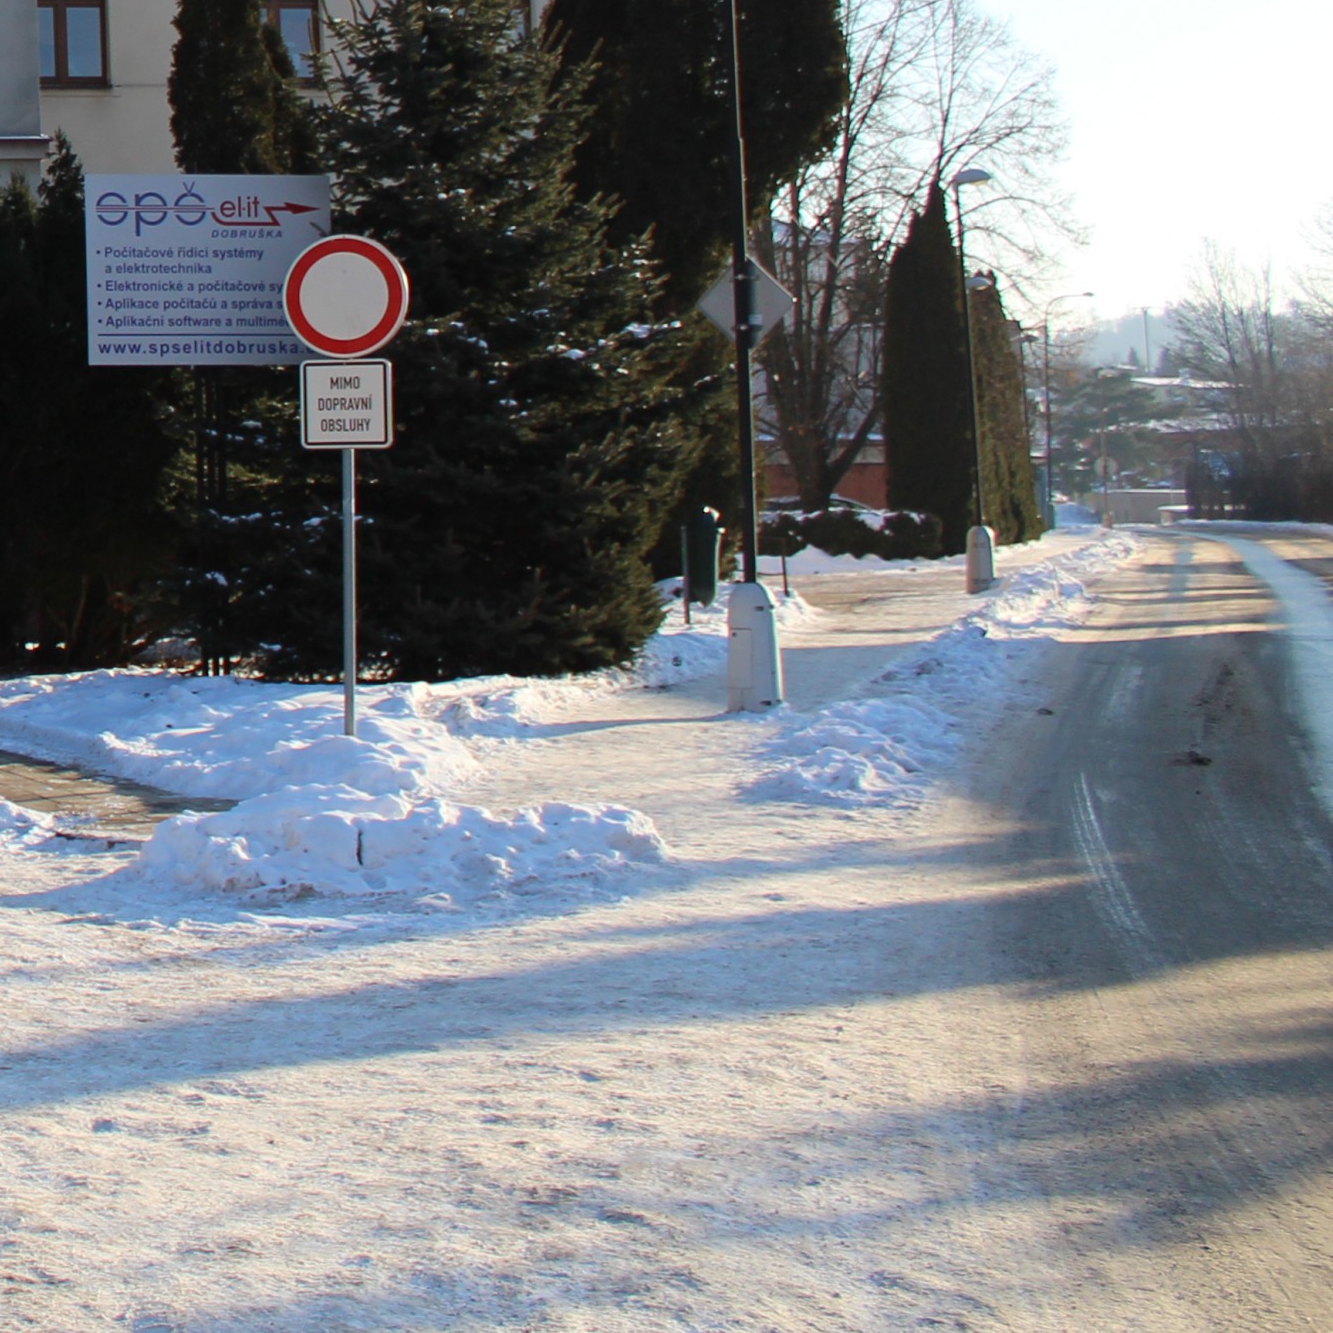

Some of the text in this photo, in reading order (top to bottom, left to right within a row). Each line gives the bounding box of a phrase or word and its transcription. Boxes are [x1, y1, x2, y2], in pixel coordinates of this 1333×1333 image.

[211, 228, 283, 239] DOBRUŠKA
[104, 246, 174, 259] Počítačové
[212, 247, 264, 260] systémy
[104, 263, 212, 274] a elektrotechnika
[105, 280, 184, 292] Elektronické
[187, 283, 195, 292] a
[198, 280, 266, 294] počítačové
[105, 298, 159, 311] Aplikace
[163, 297, 217, 311] počítačů
[220, 301, 228, 309] a
[231, 298, 273, 312] správa
[105, 315, 290, 329] Aplikační software a multimé
[98, 341, 315, 357] www.spselitdobruska.c
[330, 376, 361, 390] MIMO
[317, 394, 373, 411] DOPRAVNÍ
[320, 418, 371, 432] OBSLUHY
